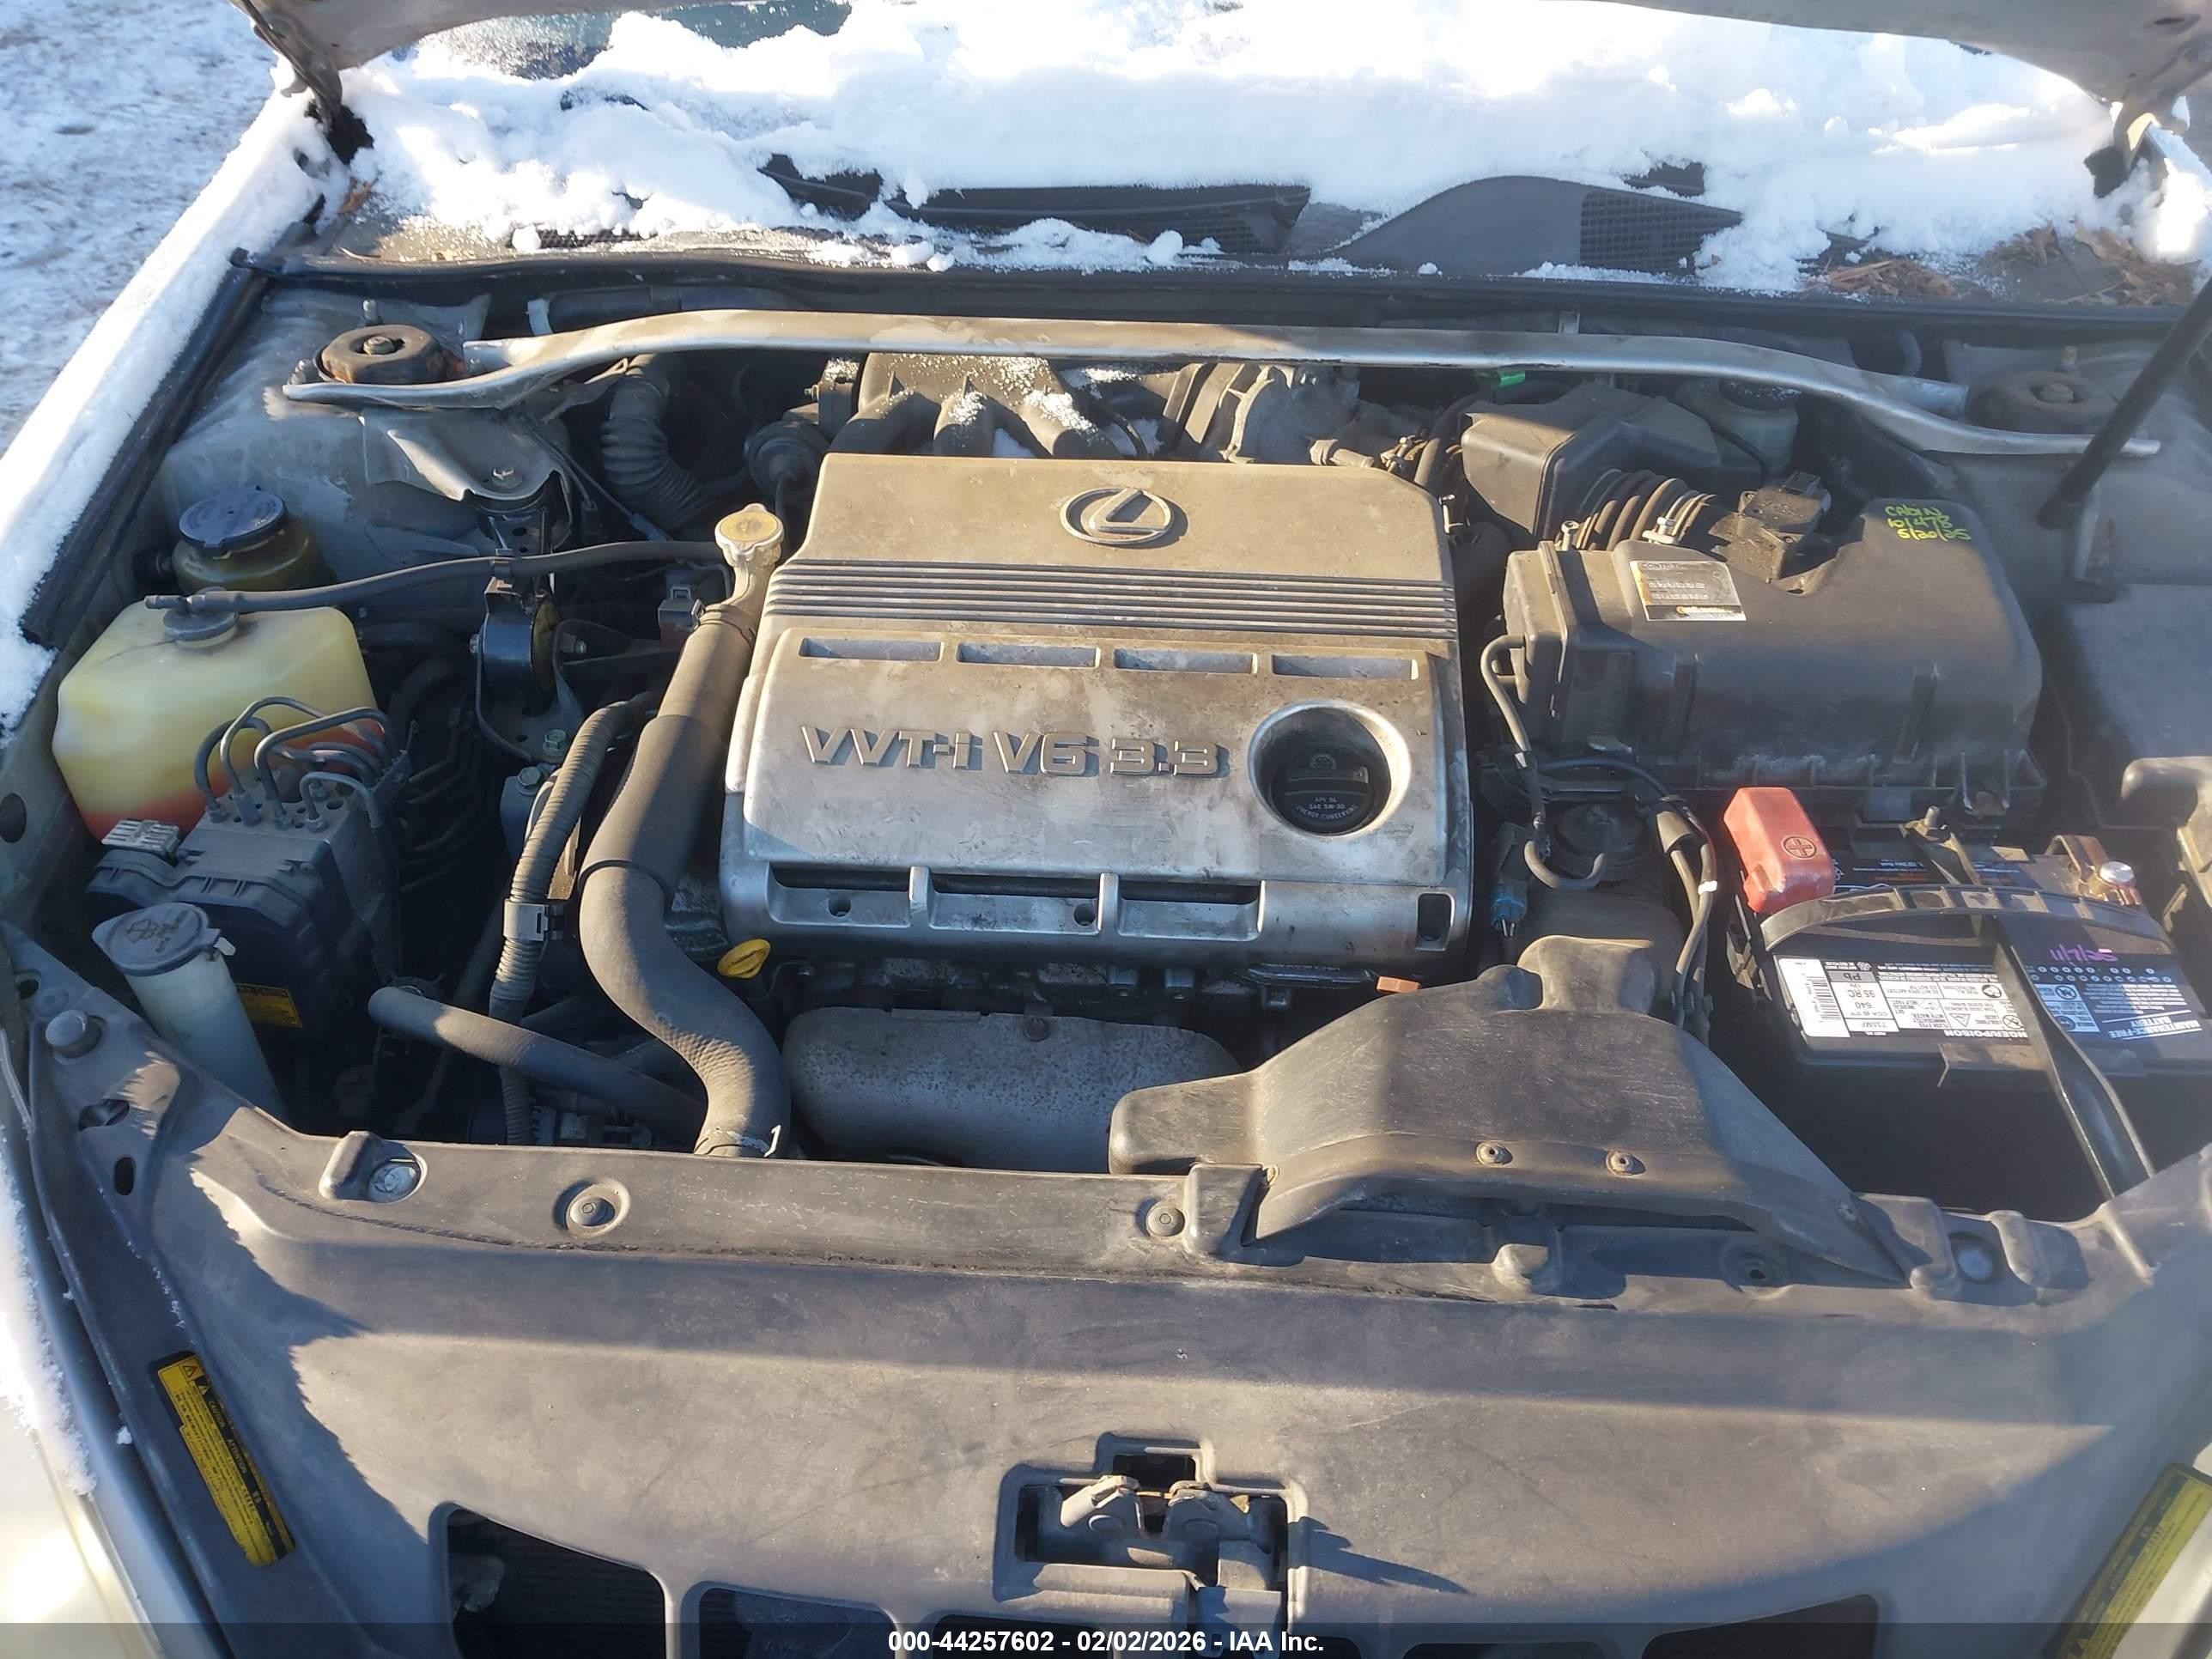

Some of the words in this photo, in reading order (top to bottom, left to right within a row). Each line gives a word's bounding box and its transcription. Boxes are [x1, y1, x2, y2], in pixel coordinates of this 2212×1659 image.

[994, 730, 1091, 775] V6
[1110, 738, 1221, 777] 3.3
[1843, 972, 1862, 981] Pb
[1847, 989, 1863, 998] RC
[2130, 1016, 2172, 1027] BATTERY
[2107, 1019, 2201, 1038] MAINTENANCE-FREE
